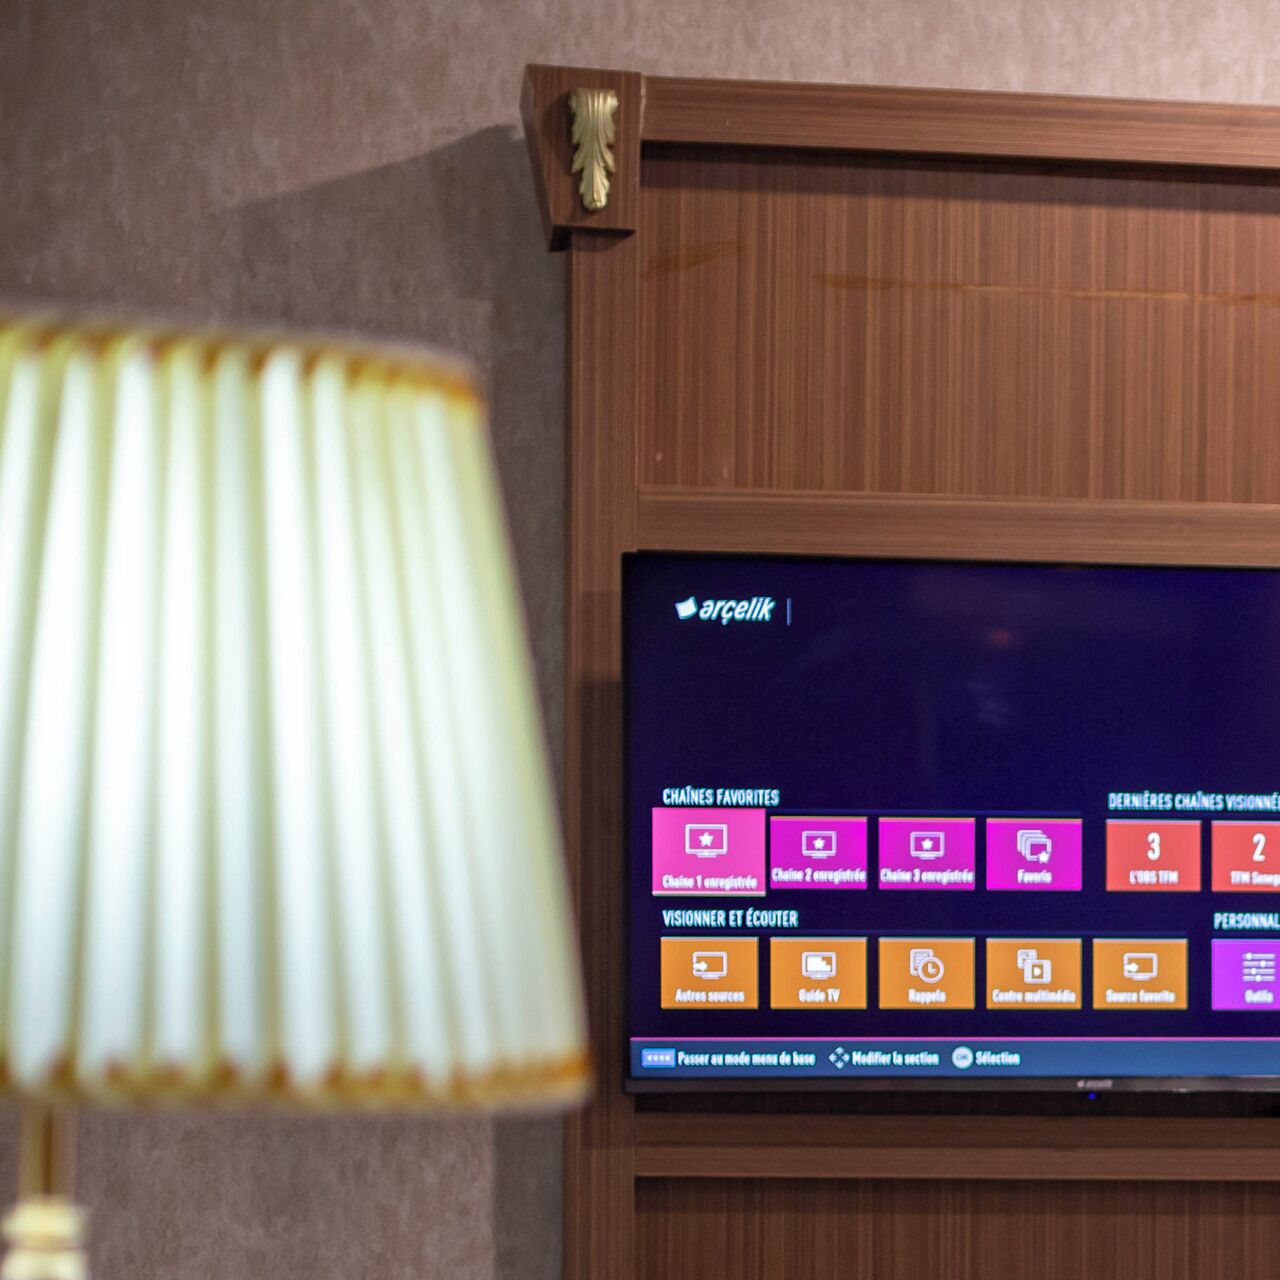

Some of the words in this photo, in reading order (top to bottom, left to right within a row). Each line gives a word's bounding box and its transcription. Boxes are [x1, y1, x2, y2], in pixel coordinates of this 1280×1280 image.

[699, 597, 776, 626] arçelik
[662, 785, 714, 806] CHAÎNES
[716, 788, 780, 806] FAVORITES
[1108, 790, 1173, 811] DERNIÈRES
[1174, 791, 1224, 811] CHAÎNES
[1146, 831, 1161, 861] 3
[1252, 832, 1266, 862] 2
[696, 874, 703, 889] 1
[805, 867, 812, 882] 2
[913, 868, 920, 883] 3
[662, 908, 726, 927] VISIONNER
[728, 909, 743, 927] ET
[745, 907, 799, 928] ÉCOUTER
[675, 987, 706, 1003] Autres
[707, 990, 745, 1003] sources
[798, 988, 826, 1003] Guide
[826, 988, 840, 1002] TV
[677, 1050, 709, 1066] Passer
[710, 1053, 724, 1066] au
[724, 1050, 751, 1067] mode
[752, 1053, 778, 1067] menu
[779, 1050, 792, 1067] de
[792, 1050, 816, 1067] base
[852, 1050, 892, 1066] Modifier
[892, 1050, 903, 1066] la
[904, 1050, 940, 1067] section
[975, 1050, 1021, 1067] Sélection
